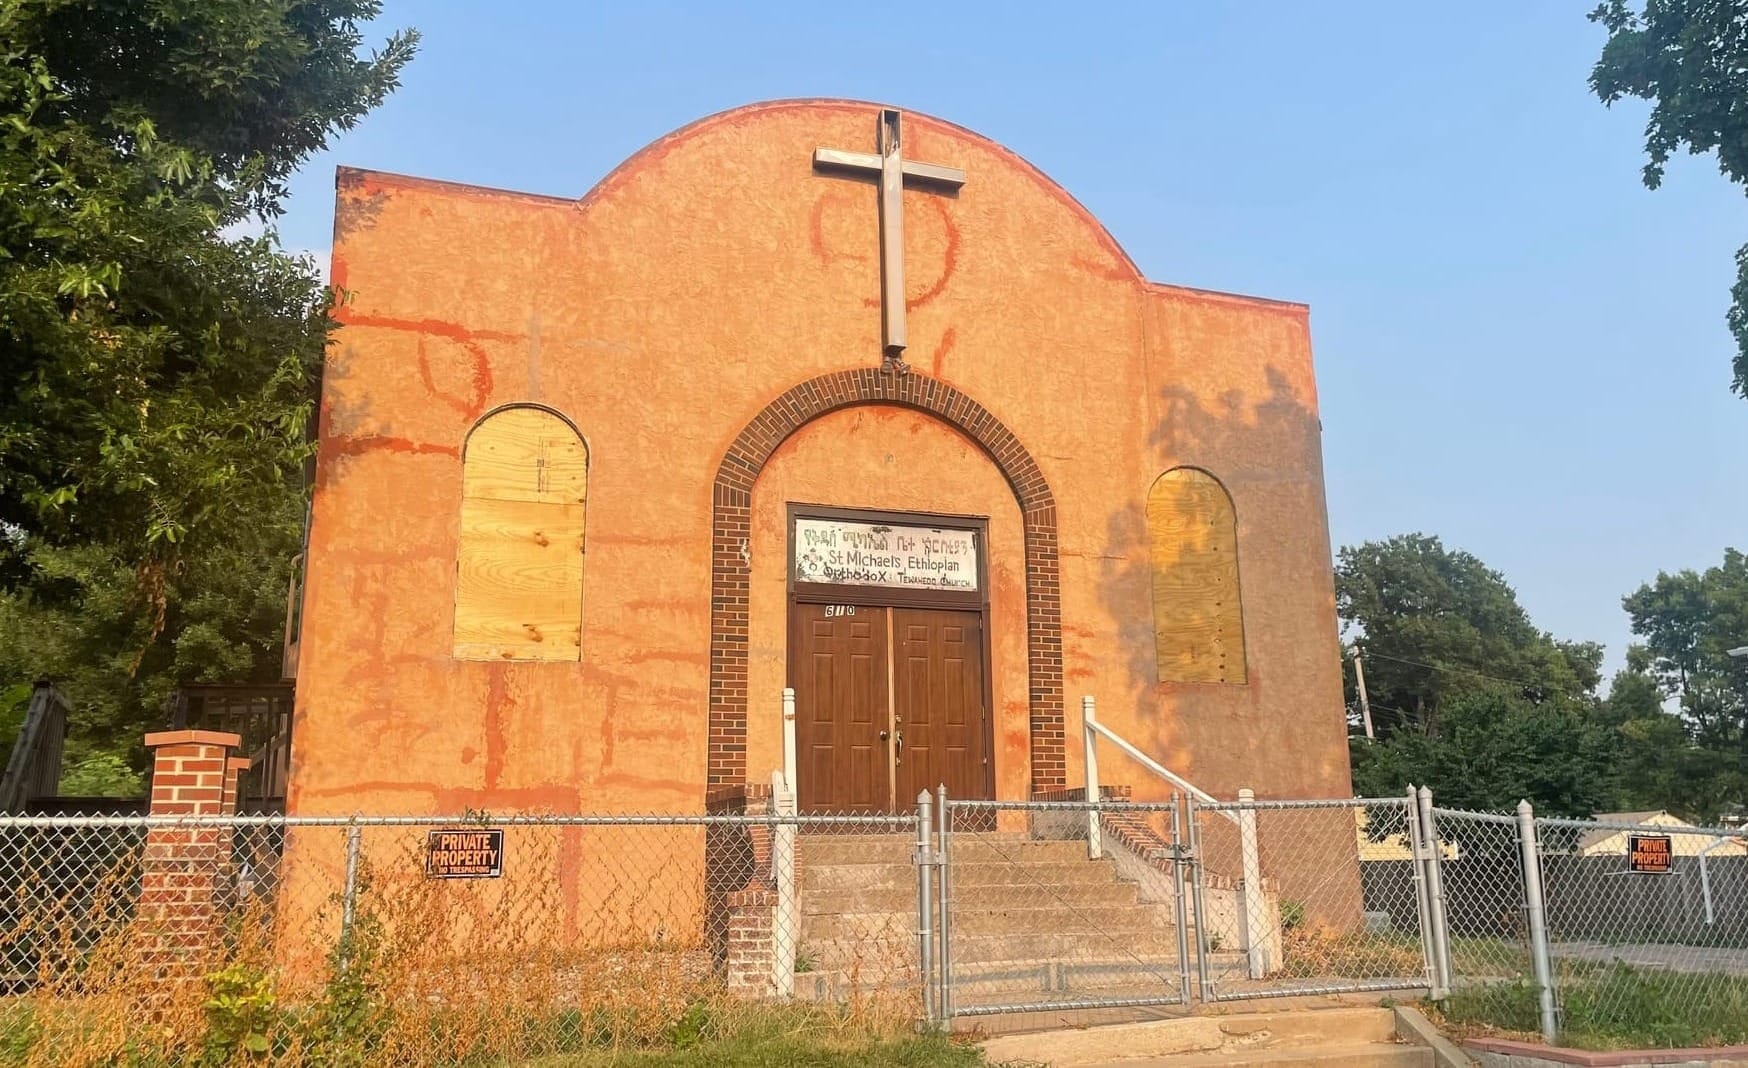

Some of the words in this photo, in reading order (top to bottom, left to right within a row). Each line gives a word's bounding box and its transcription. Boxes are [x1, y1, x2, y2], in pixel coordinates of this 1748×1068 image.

[829, 550, 843, 565] St
[908, 556, 959, 573] Ethiopian
[441, 834, 491, 849] PRIVATE
[1638, 839, 1667, 851] PRIVATE
[431, 850, 497, 865] PROPERTY
